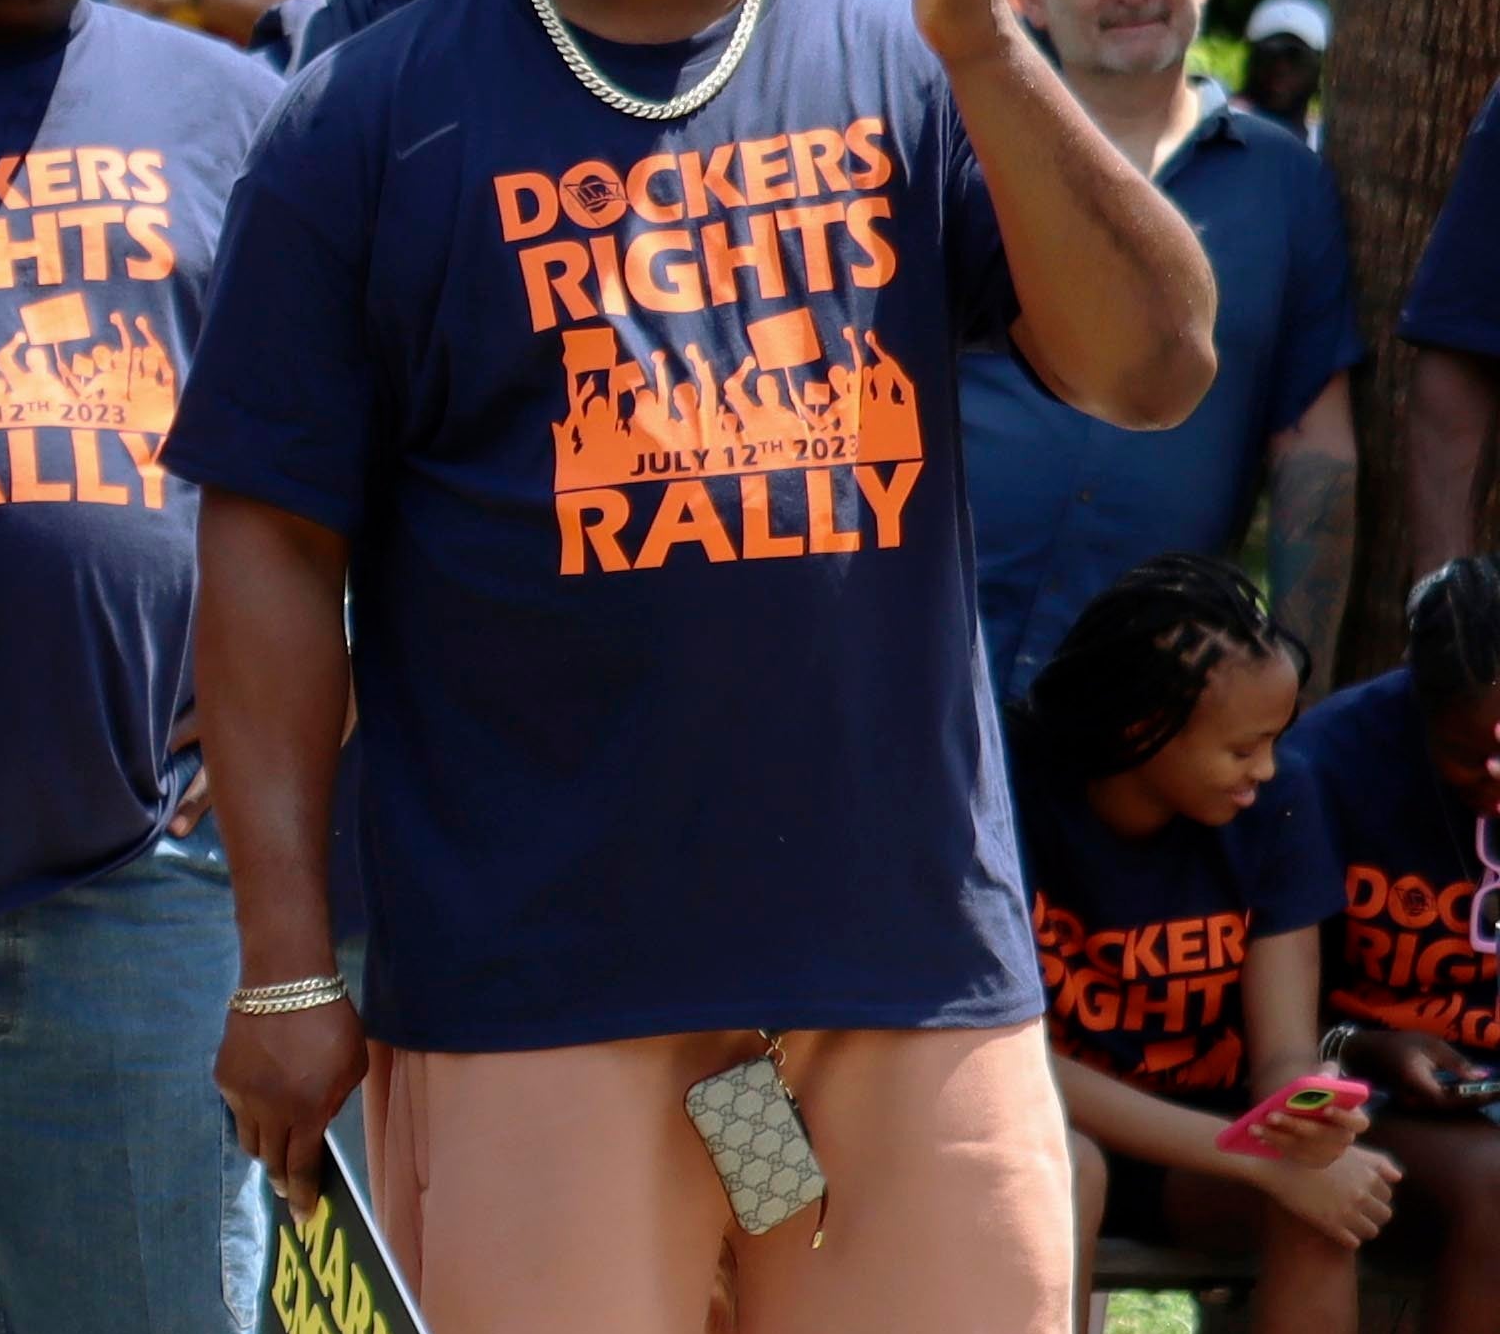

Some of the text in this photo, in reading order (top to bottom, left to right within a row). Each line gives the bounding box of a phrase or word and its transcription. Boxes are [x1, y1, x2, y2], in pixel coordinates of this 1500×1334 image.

[493, 116, 893, 243] DOCKERS
[518, 194, 897, 334] RIGHTS
[59, 403, 127, 425] 2023
[629, 448, 710, 478] JULY
[794, 434, 861, 464] 2023
[554, 460, 924, 577] RALLY
[1032, 889, 1251, 981] OCKER
